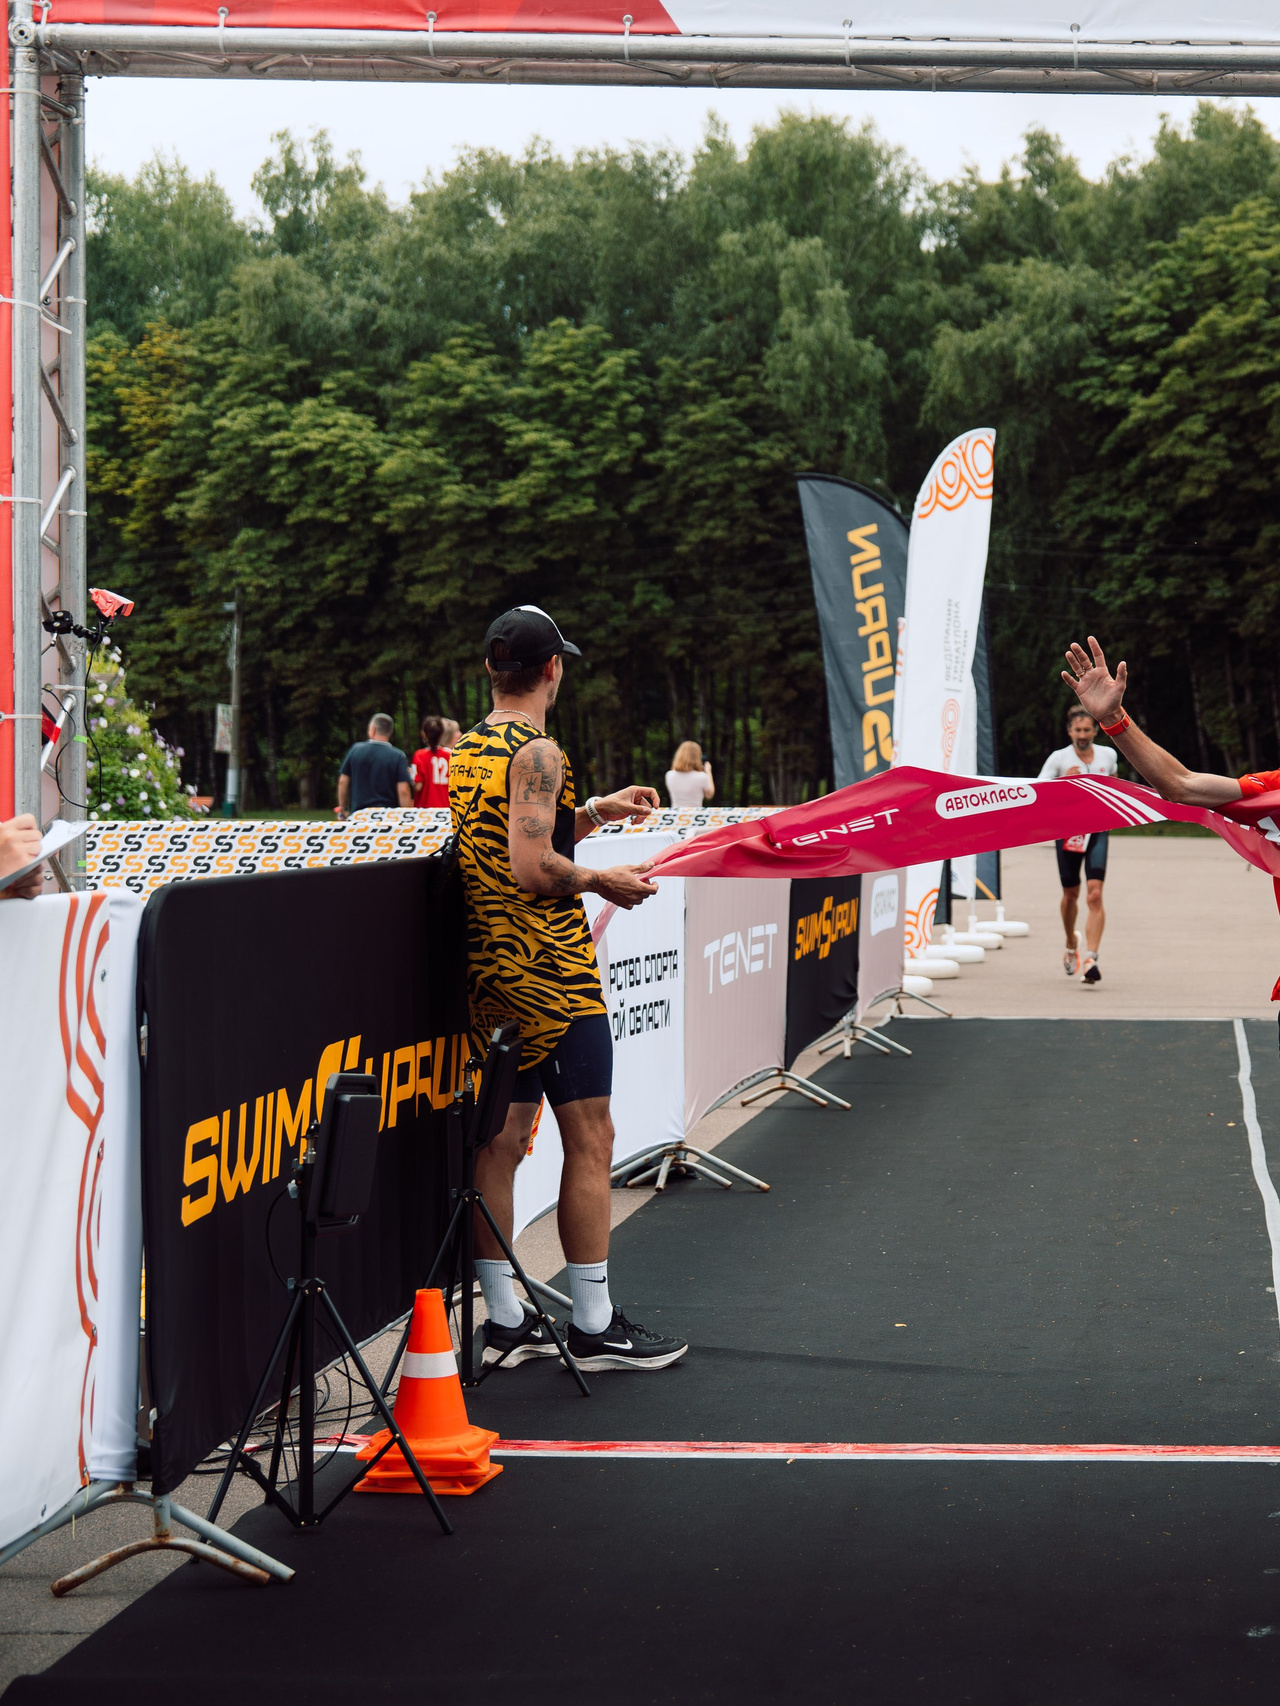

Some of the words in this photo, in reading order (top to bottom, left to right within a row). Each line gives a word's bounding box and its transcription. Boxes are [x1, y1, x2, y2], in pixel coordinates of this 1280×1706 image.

[431, 756, 448, 785] 12
[945, 787, 1028, 812] АВТОКЛАСС
[644, 949, 679, 984] СПОРТА
[703, 923, 778, 995] TENET
[629, 999, 671, 1036] ОБЛАСТИ
